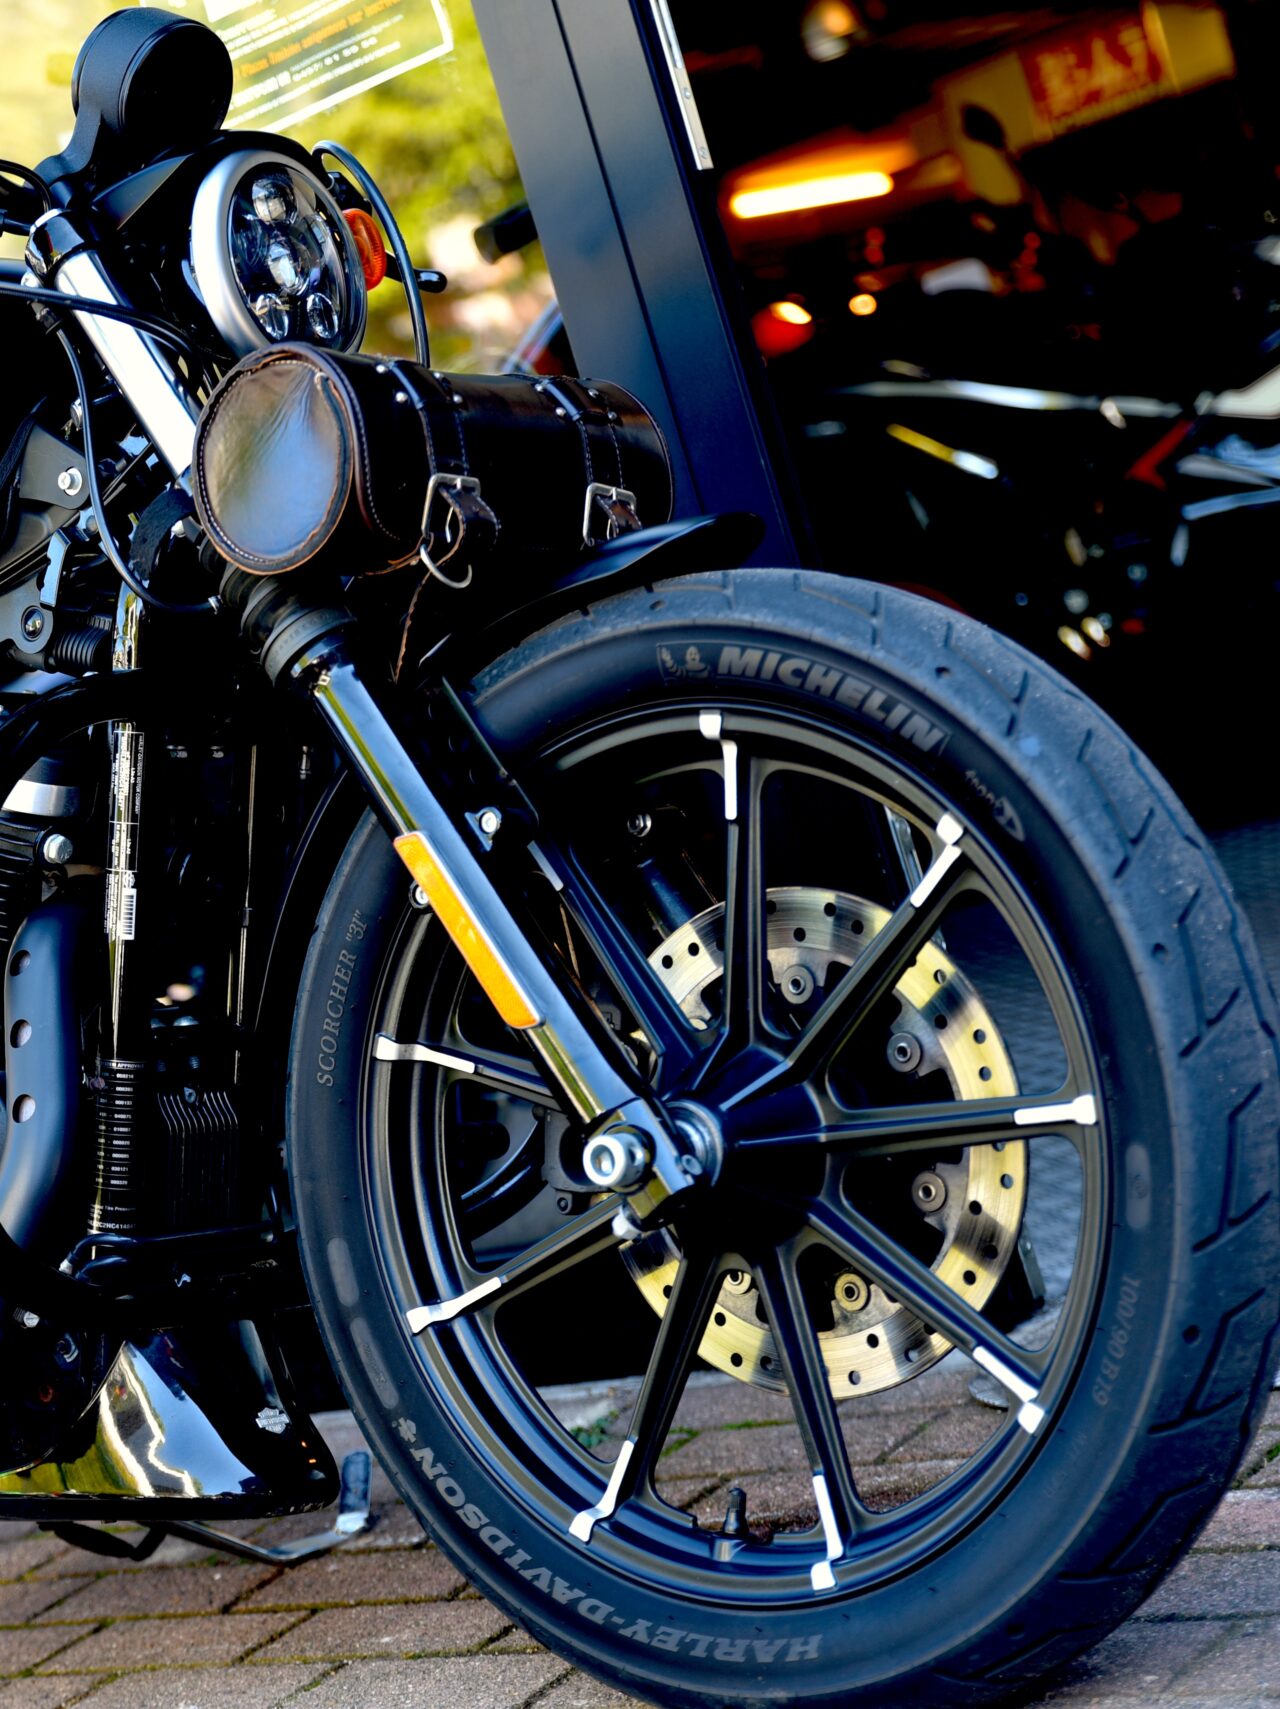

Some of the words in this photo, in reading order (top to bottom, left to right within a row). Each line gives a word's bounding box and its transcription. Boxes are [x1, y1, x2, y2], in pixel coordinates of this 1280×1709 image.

[719, 646, 946, 752] MICHELIN
[317, 949, 358, 1087] SCORCHER
[410, 1447, 824, 1664] HARLEY-DAVIDSON
